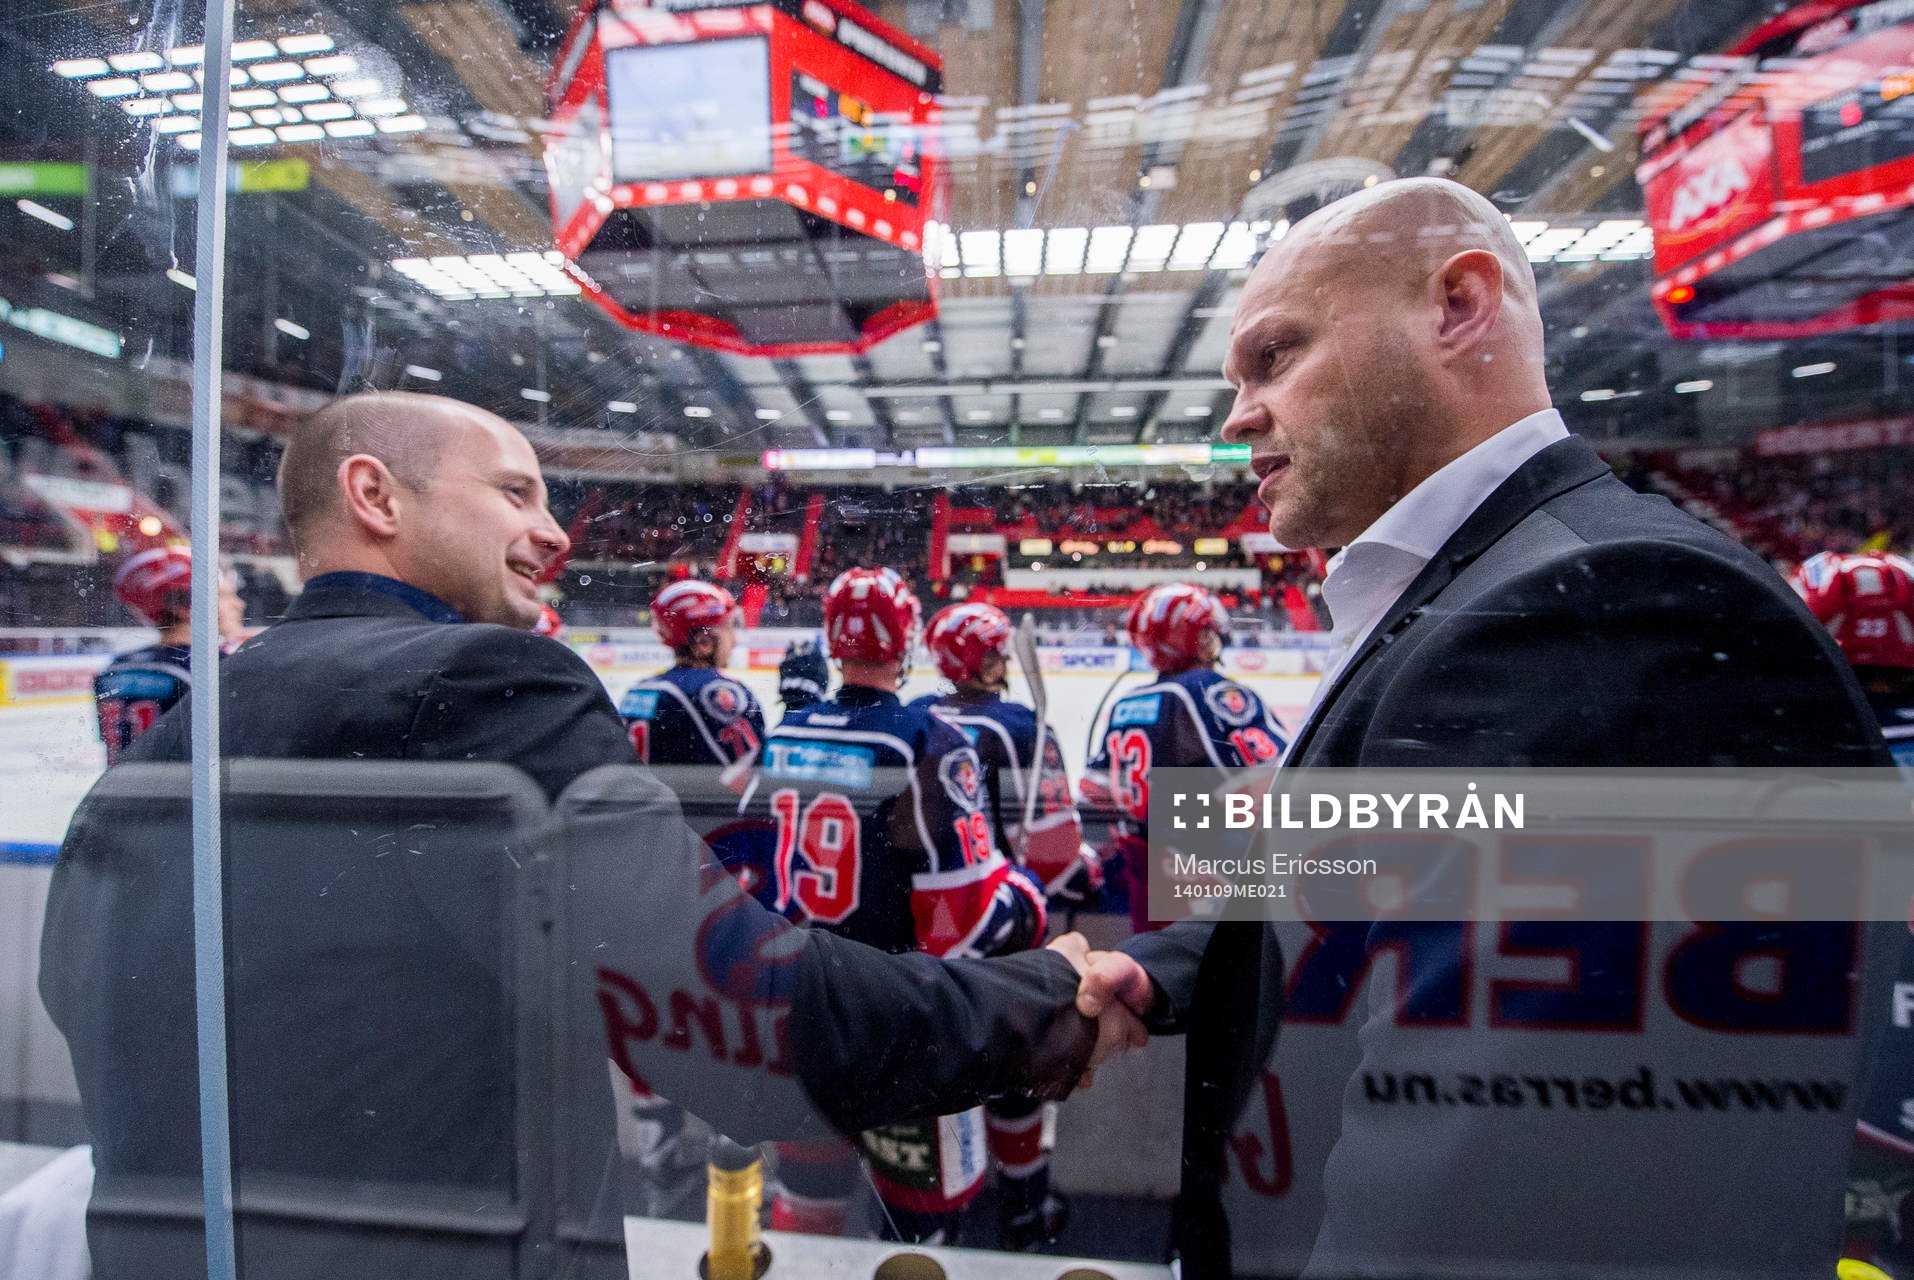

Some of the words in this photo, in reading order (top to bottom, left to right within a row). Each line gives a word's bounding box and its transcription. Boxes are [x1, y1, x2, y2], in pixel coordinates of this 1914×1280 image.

[1228, 727, 1279, 766] 13
[771, 788, 861, 923] 19
[954, 811, 991, 866] 19
